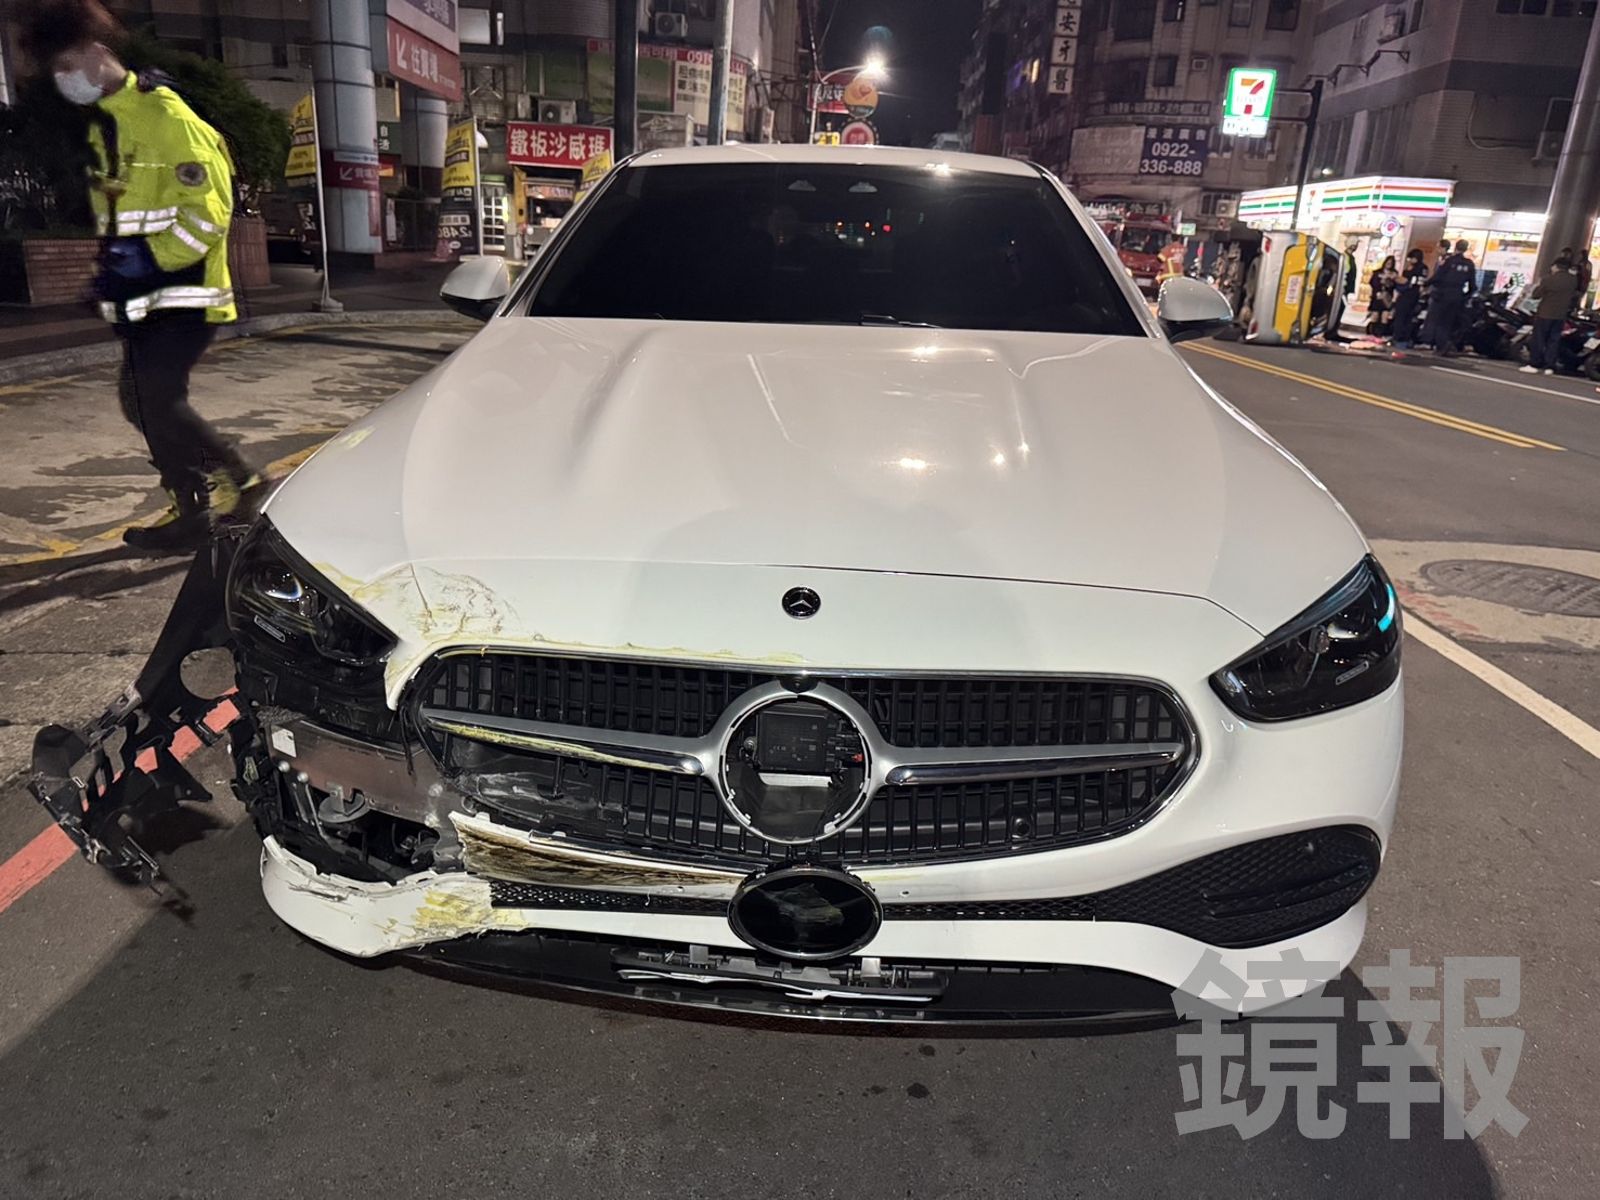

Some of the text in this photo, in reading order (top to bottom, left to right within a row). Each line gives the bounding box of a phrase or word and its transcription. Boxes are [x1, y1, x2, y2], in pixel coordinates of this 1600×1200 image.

[510, 128, 606, 160] 鐵板沙威瑪
[1151, 142, 1196, 157] 0922-
[1140, 159, 1202, 175] 336-888
